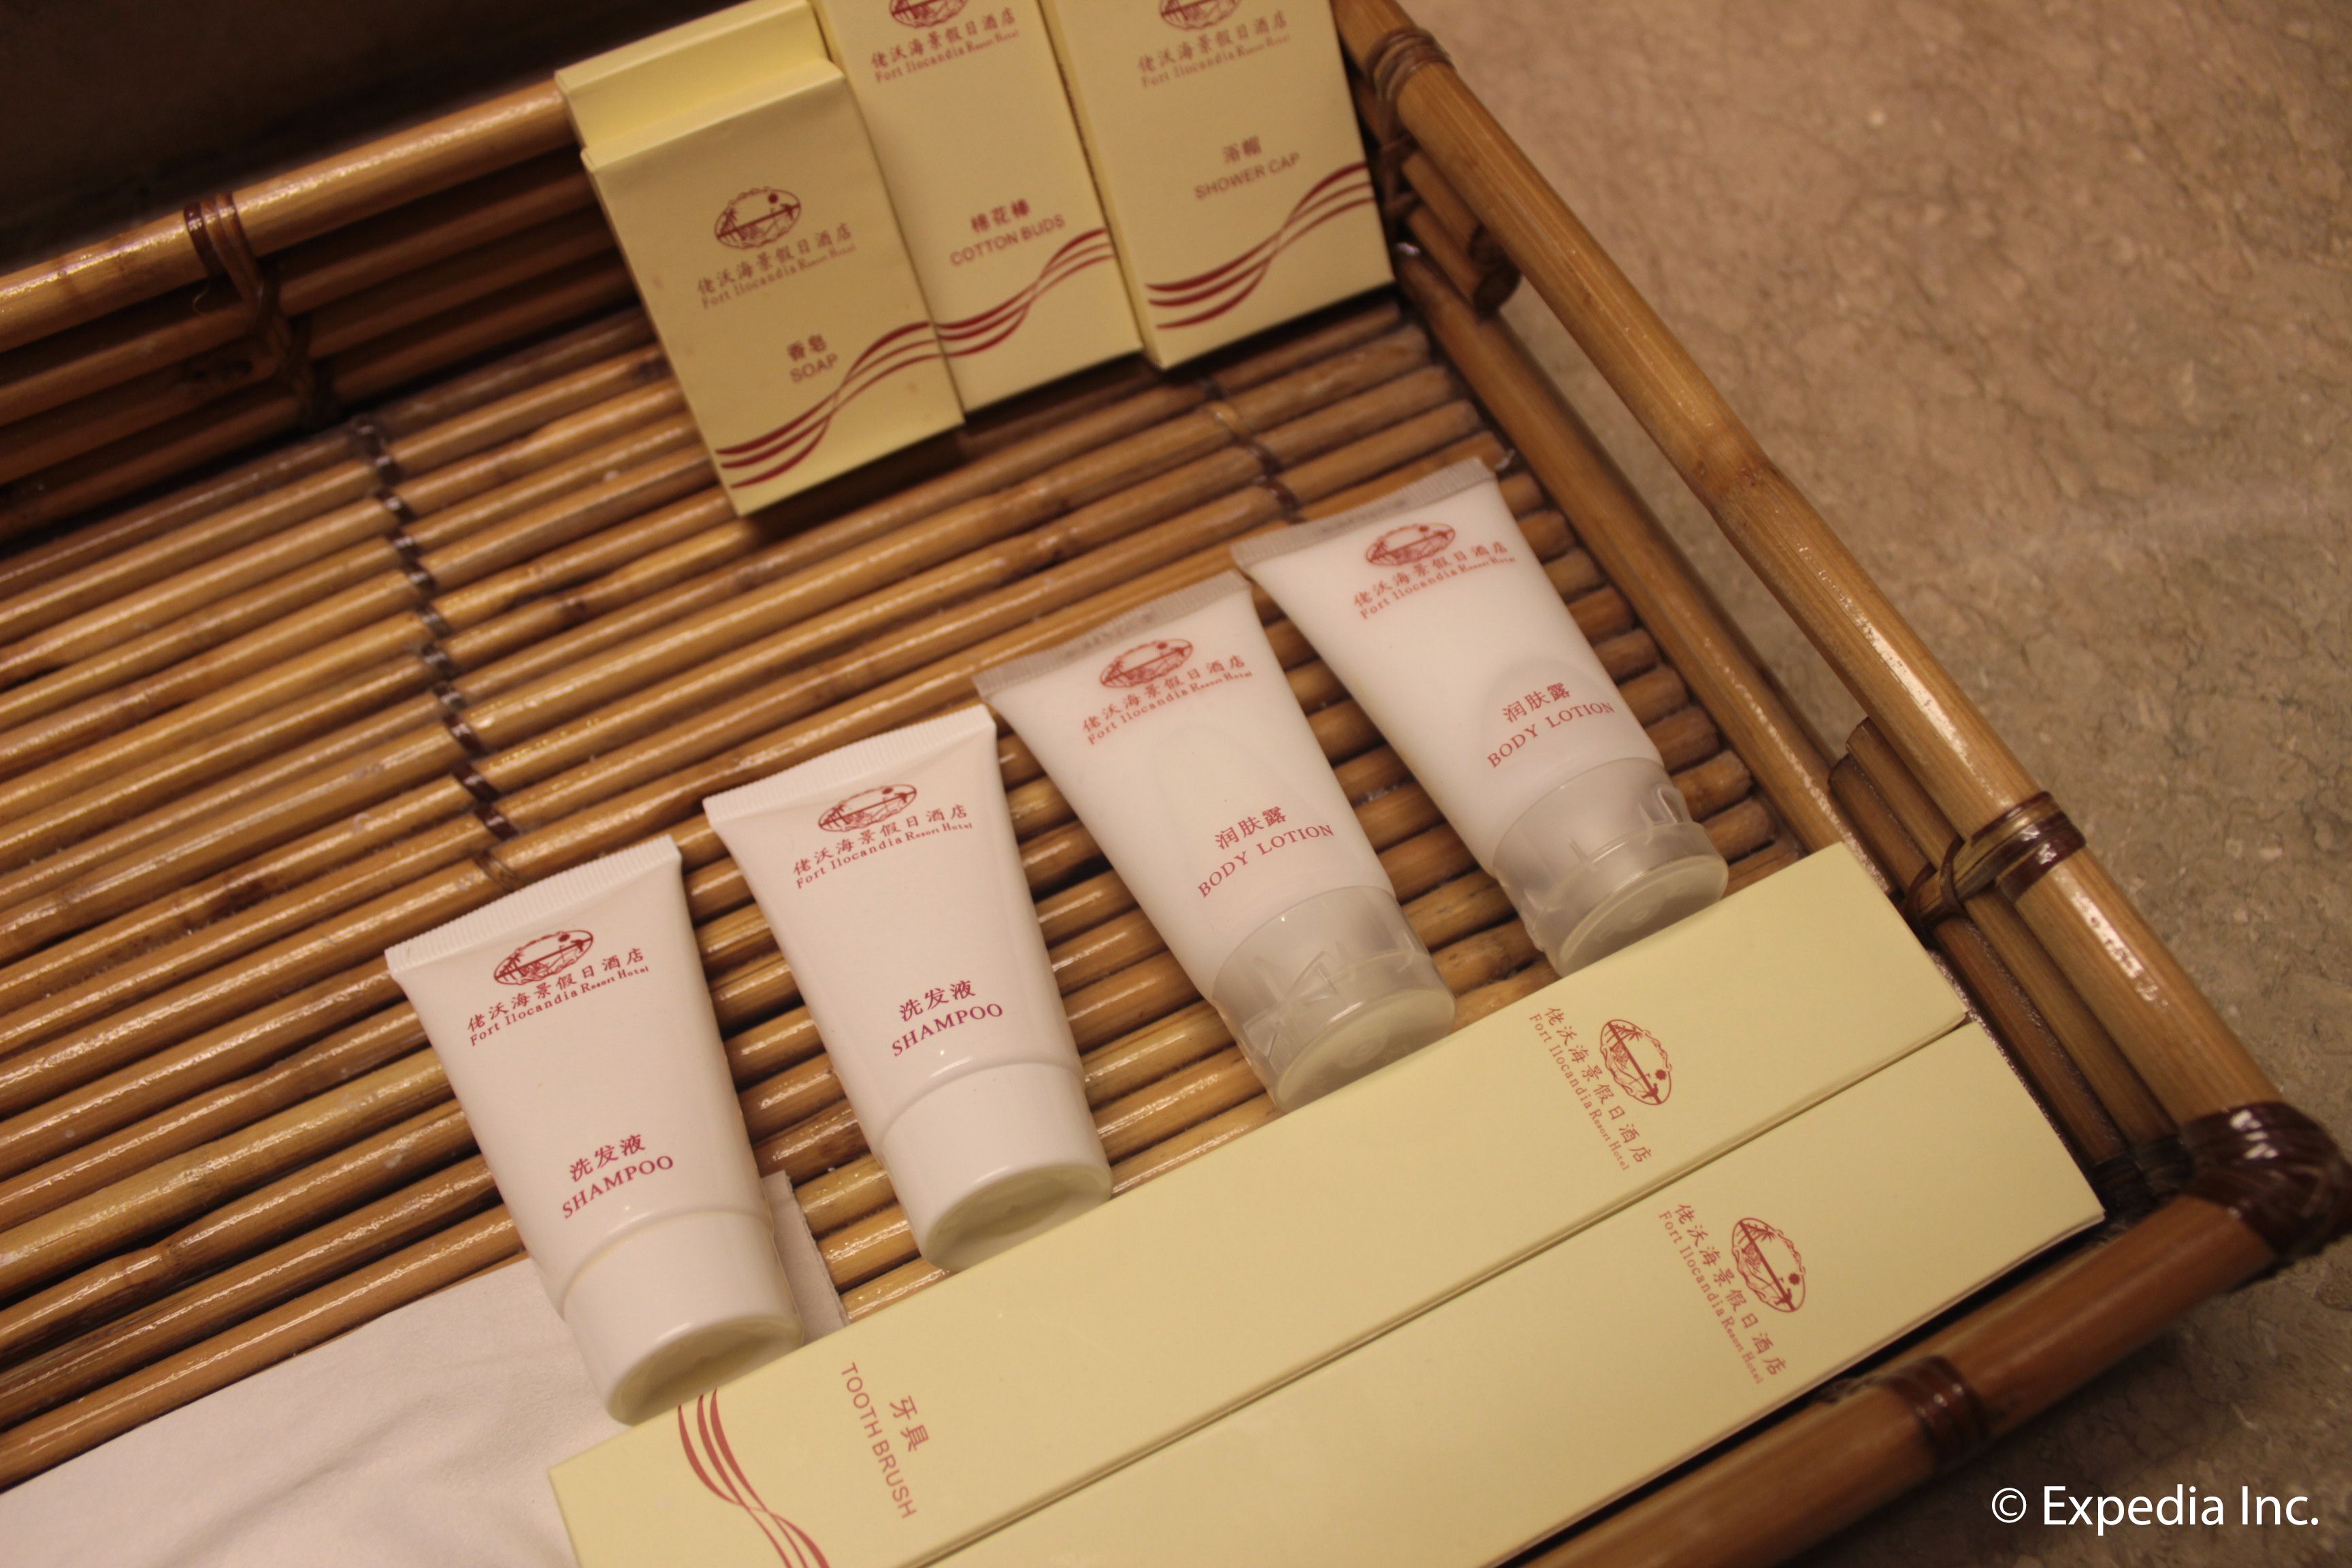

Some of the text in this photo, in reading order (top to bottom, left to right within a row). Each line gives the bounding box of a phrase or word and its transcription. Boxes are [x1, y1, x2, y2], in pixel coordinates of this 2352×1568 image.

[1194, 152, 1300, 199] SHOWER CAP
[950, 214, 1065, 265] COTTON BUDS
[790, 353, 838, 382] SOAP
[1502, 682, 1571, 723] 润肤露
[1088, 723, 1117, 745] Fort
[1487, 702, 1616, 768] BODY LOTION
[1215, 806, 1286, 850] 润肤露
[796, 823, 973, 889] Fort Ilocandia Resort Hotel
[1198, 825, 1334, 898] BODY LOTION
[470, 966, 649, 1046] Fort Ilocandia Resort Hotel
[899, 980, 976, 1022] 洗发液
[892, 1004, 1002, 1057] SHAMPOO
[1530, 1013, 1630, 1171] Fort Ilocandia Resort Hotel
[570, 1134, 645, 1182] 洗发液
[562, 1156, 674, 1219] SHAMPOO
[1659, 1211, 1682, 1244] Fort
[1680, 1245, 1725, 1317] Ilocandia
[889, 1395, 929, 1452] 牙具
